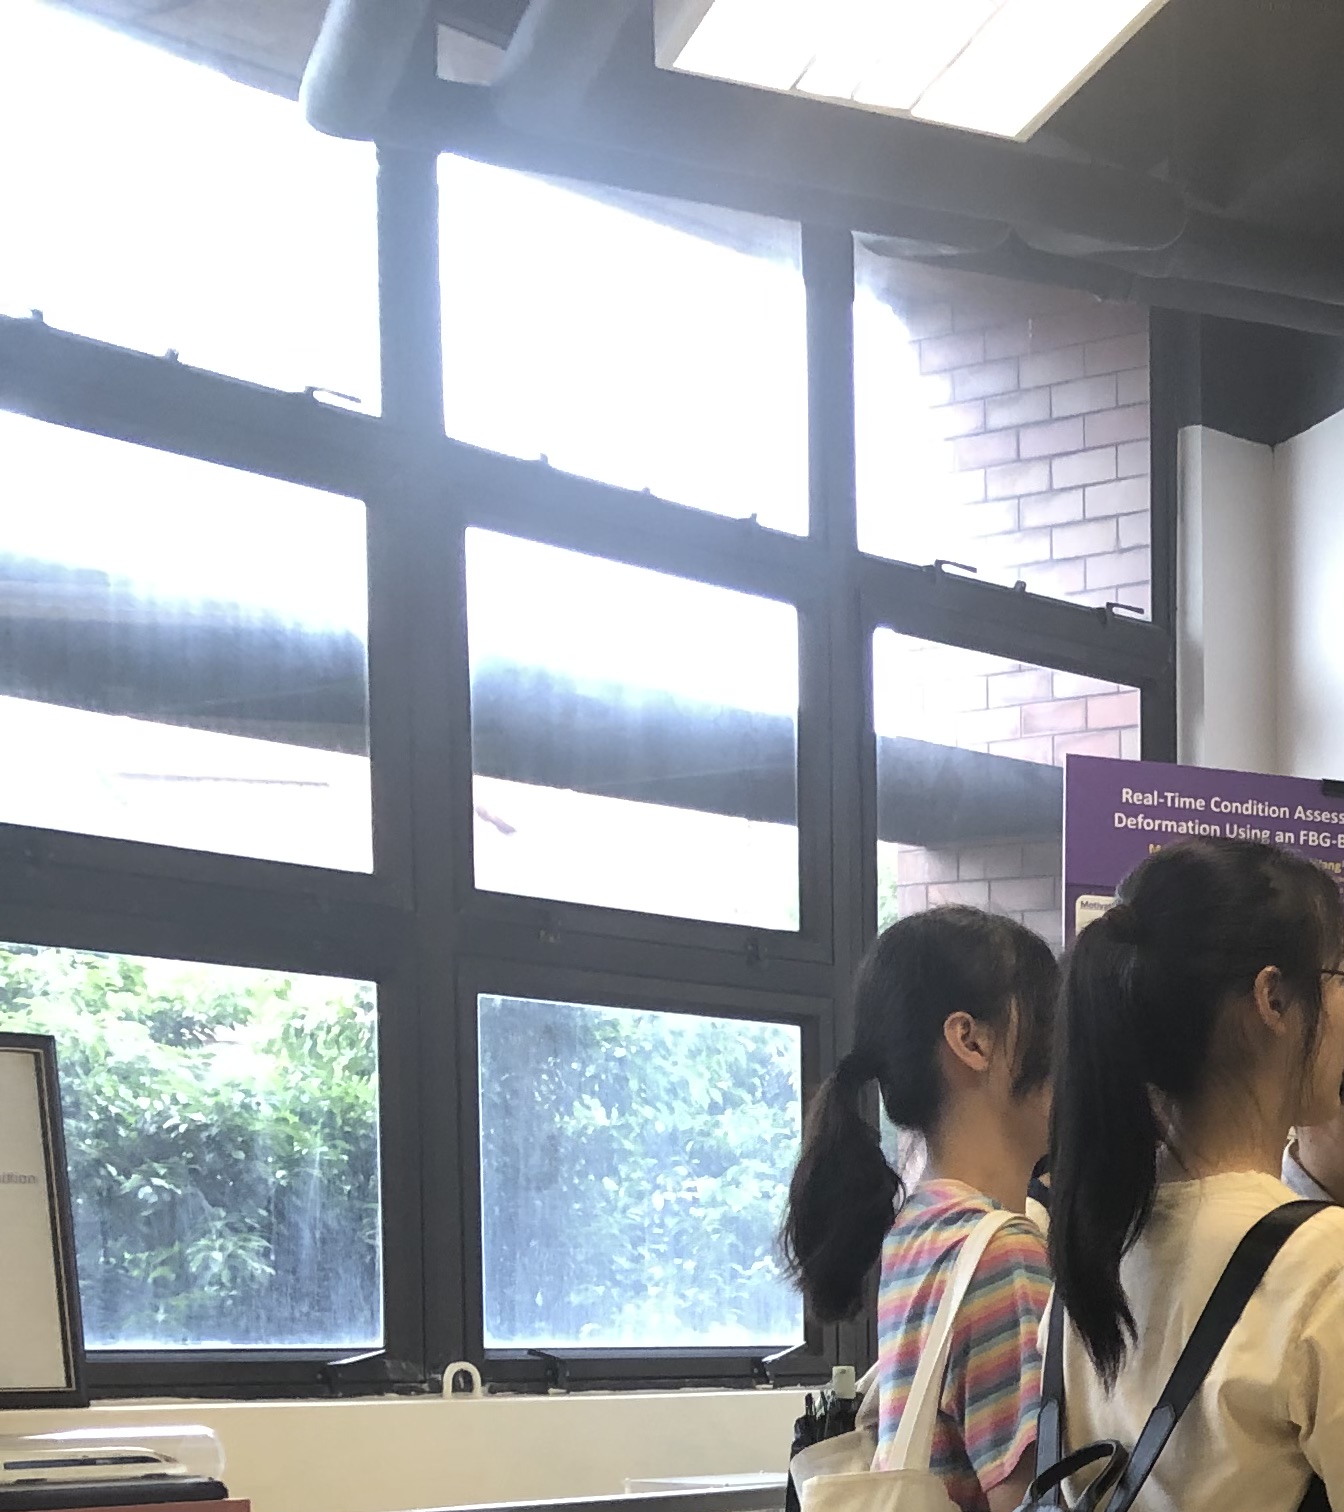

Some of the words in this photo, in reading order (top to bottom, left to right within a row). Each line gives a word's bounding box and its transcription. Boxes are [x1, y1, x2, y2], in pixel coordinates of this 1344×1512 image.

[1122, 788, 1205, 811] Real-Time
[1211, 797, 1289, 818] Condition
[1114, 813, 1220, 837] Deformation
[1226, 823, 1270, 844] Using
[1275, 830, 1294, 844] an
